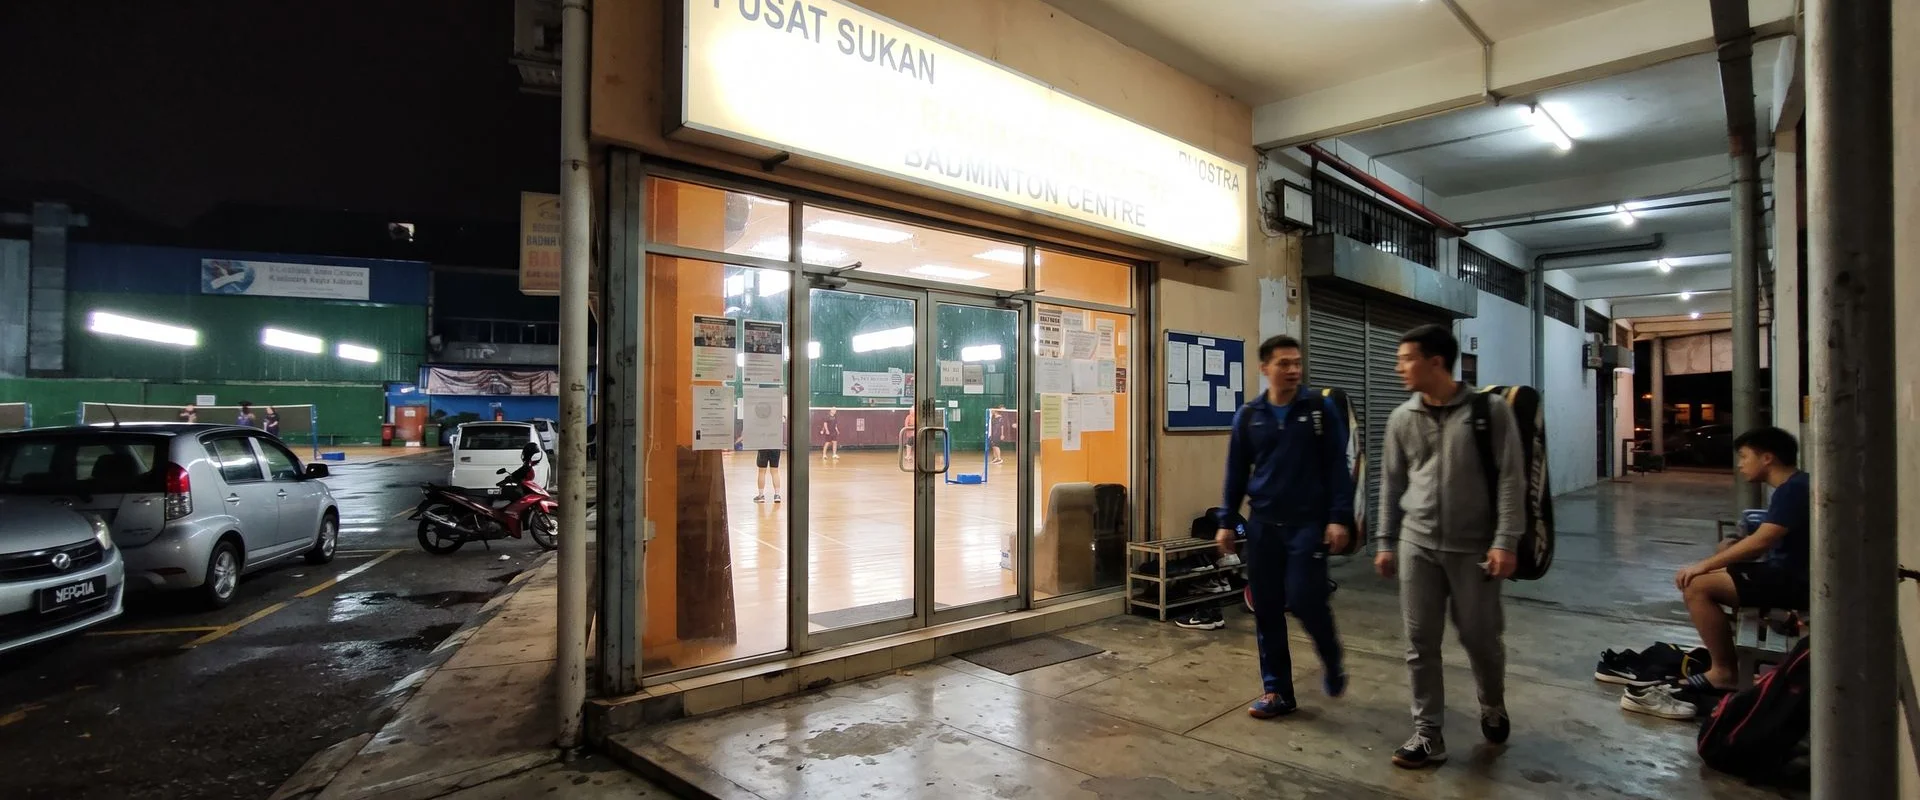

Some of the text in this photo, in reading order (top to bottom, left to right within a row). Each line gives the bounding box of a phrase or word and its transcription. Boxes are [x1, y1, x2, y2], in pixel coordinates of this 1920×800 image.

[713, 0, 936, 85] USAT SUKAN
[1066, 183, 1147, 228] CENTRE
